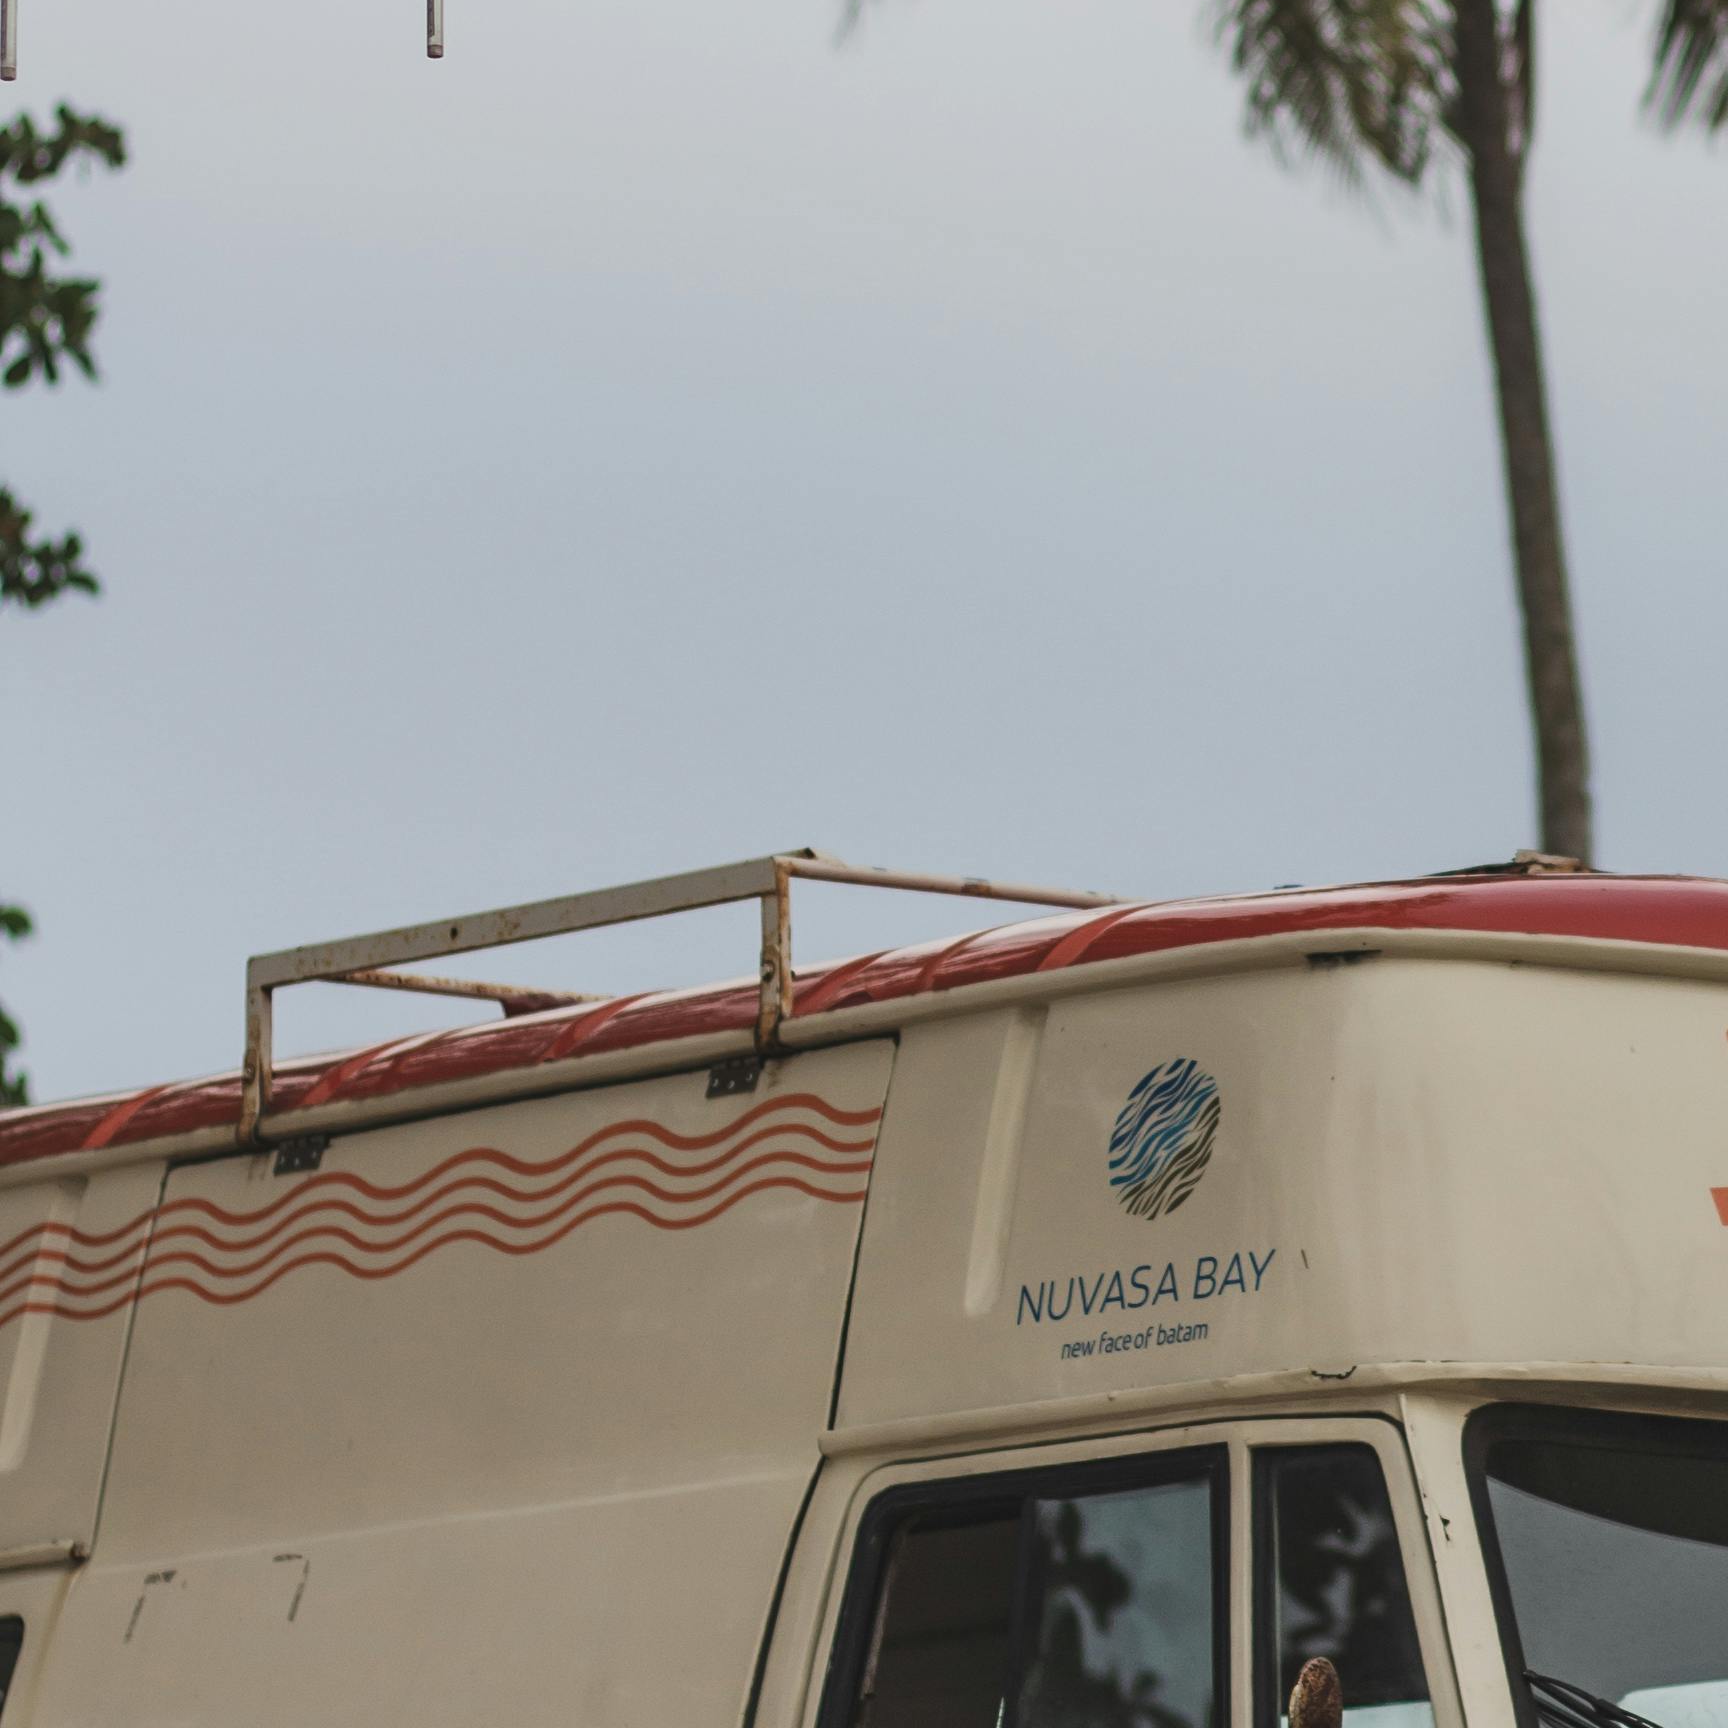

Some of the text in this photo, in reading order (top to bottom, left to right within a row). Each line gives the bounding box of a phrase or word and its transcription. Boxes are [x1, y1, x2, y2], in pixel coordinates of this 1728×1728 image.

[1017, 1249, 1276, 1325] NUVASA BAY
[1061, 1323, 1208, 1360] new face of batam
